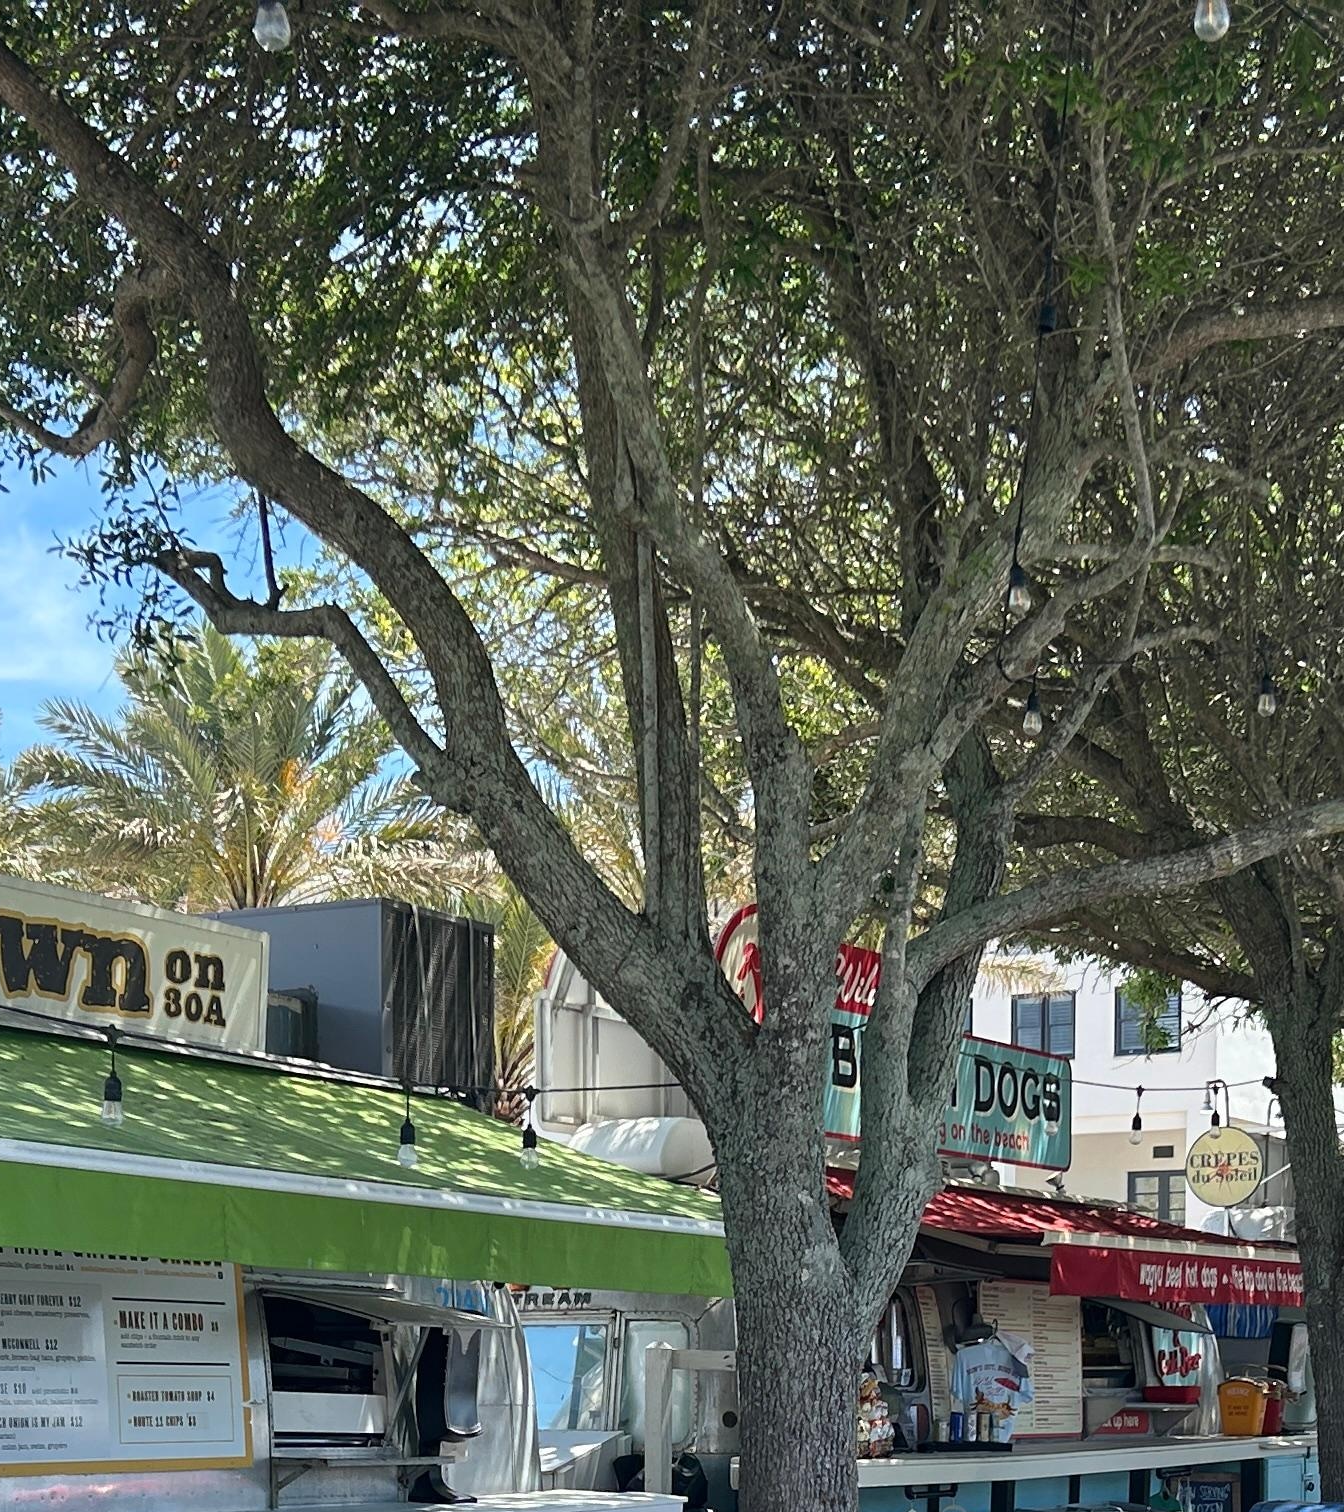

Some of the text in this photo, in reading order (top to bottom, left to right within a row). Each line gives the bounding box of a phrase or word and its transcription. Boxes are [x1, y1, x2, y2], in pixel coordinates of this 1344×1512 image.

[164, 947, 226, 992] on
[163, 987, 227, 1028] 30A
[974, 1054, 1061, 1124] DOGS
[951, 1122, 966, 1138] on
[971, 1122, 990, 1141] the
[995, 1126, 1030, 1151] beach
[1191, 1169, 1210, 1185] du
[1165, 1260, 1184, 1288] beef
[1185, 1260, 1199, 1288] hot
[1201, 1261, 1218, 1297] dogs
[1230, 1264, 1244, 1290] the
[512, 1292, 592, 1306] TREAM
[118, 1310, 204, 1332] MAKE IT A COMBO
[45, 1339, 59, 1351] $12
